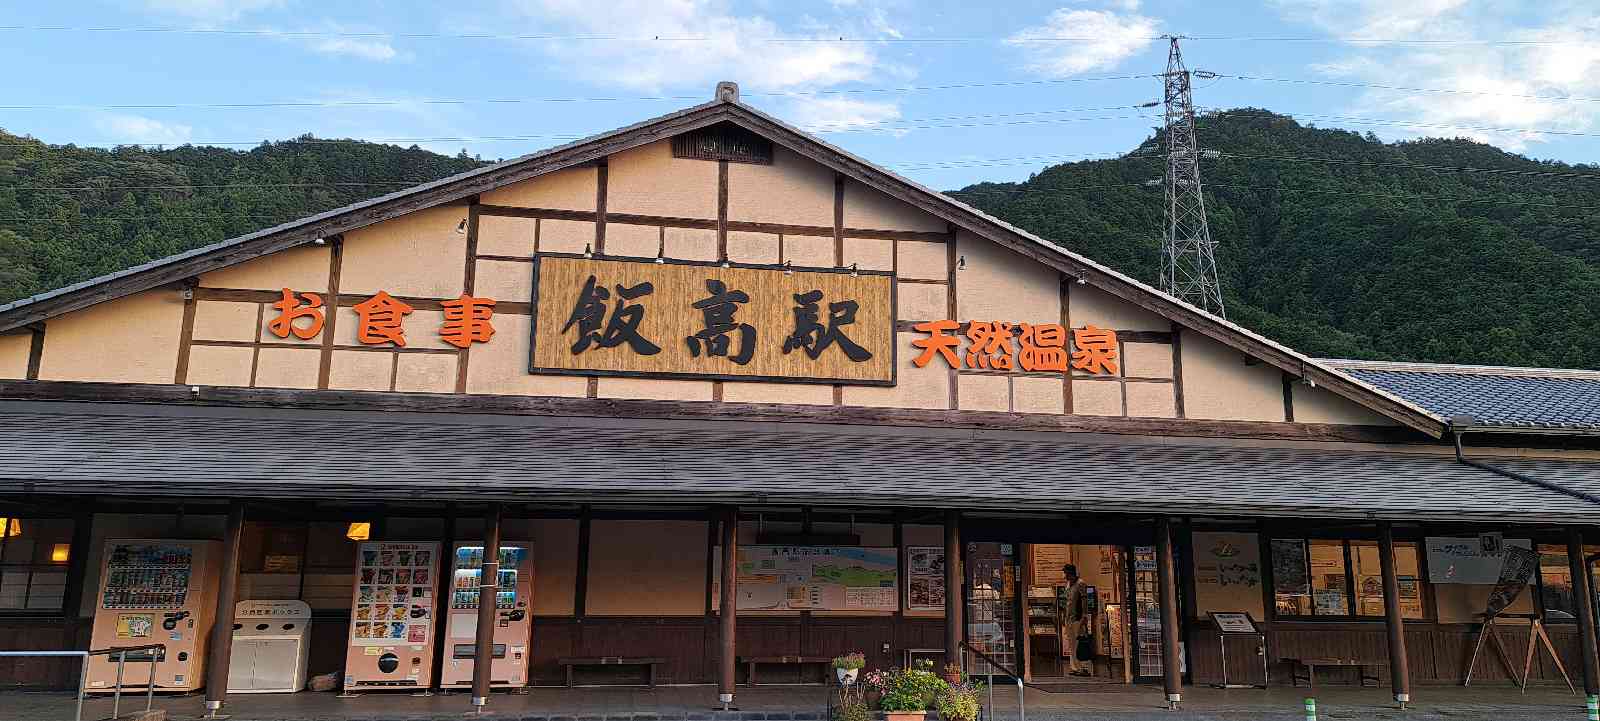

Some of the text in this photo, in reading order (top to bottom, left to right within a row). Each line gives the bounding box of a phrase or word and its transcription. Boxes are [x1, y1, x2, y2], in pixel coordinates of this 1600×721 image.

[270, 288, 497, 347] お食事
[562, 275, 873, 366] 飯高駅
[912, 319, 1119, 374] 天然温泉
